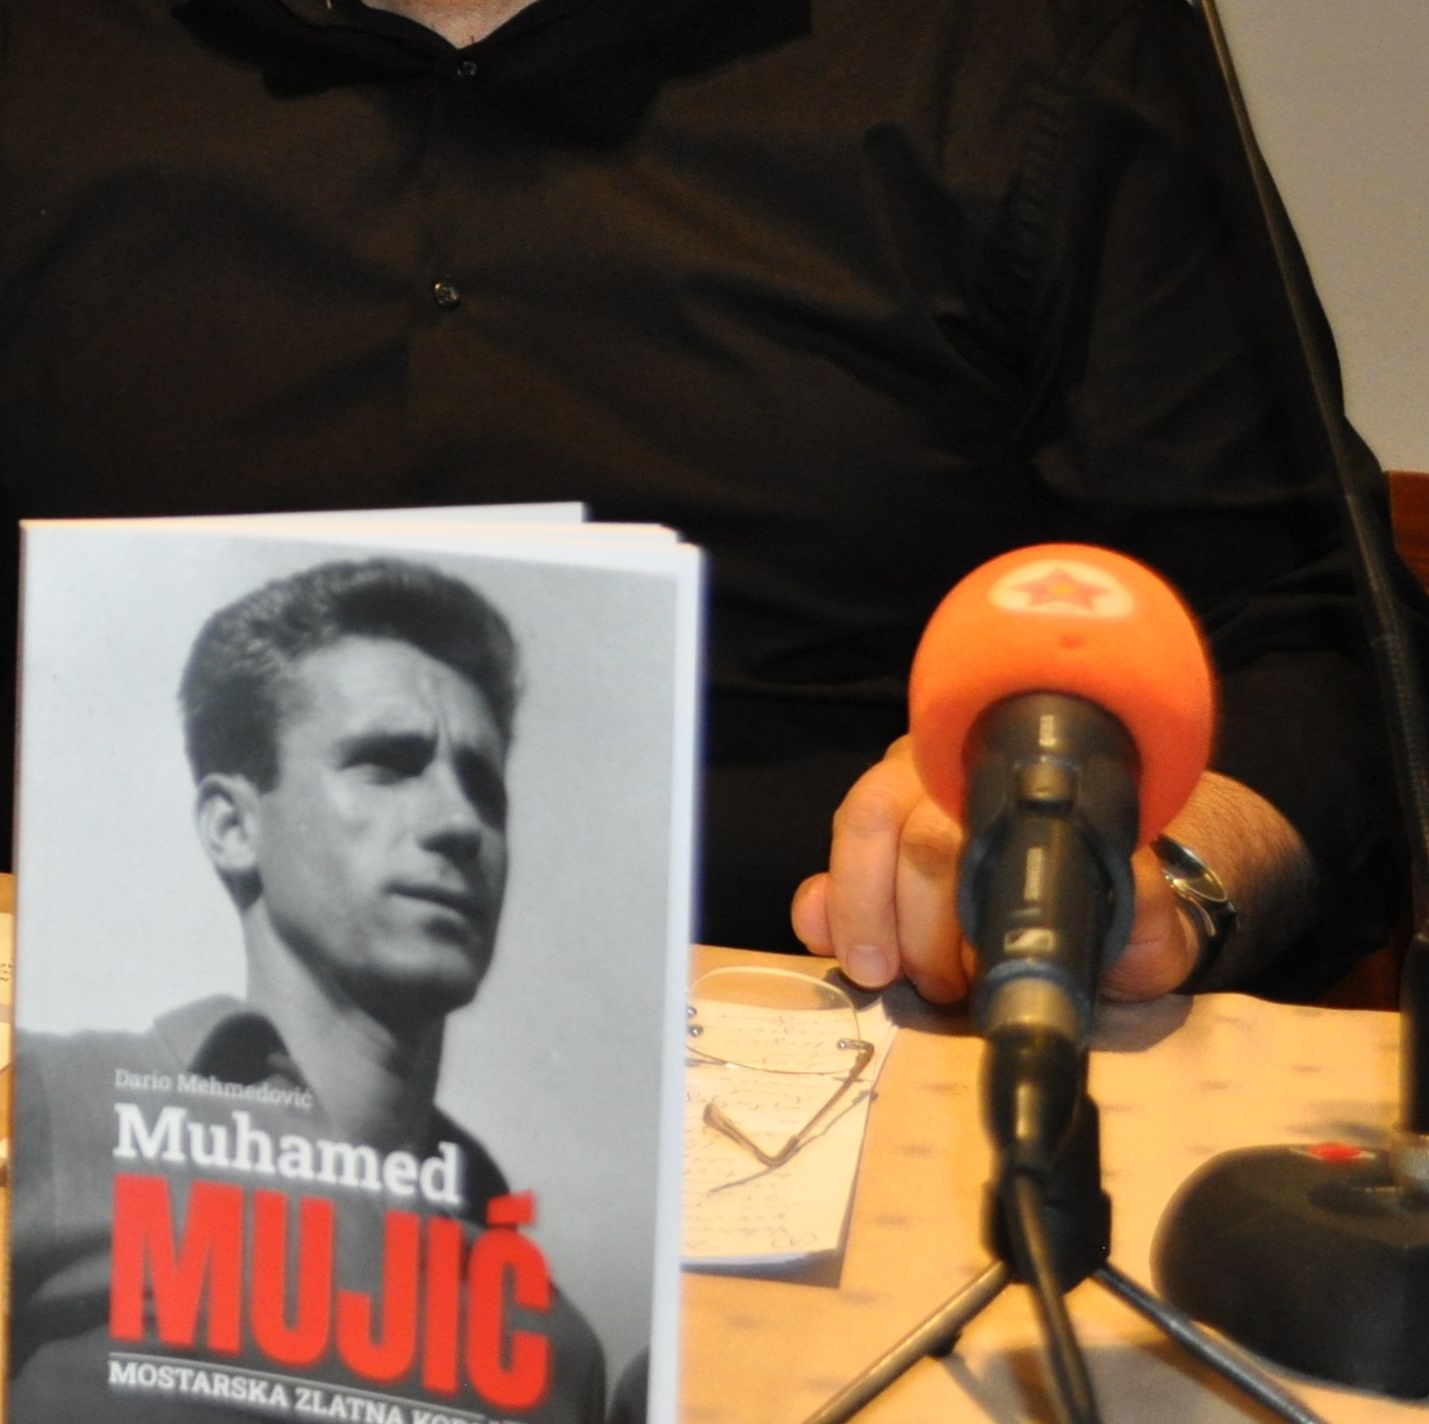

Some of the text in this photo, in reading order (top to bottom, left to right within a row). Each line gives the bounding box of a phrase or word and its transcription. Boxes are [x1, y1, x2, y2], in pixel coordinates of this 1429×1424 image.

[114, 1067, 314, 1109] Dario Mehmedović
[111, 1101, 463, 1207] Muhamed
[108, 1171, 554, 1411] MUJIĆ
[108, 1360, 403, 1424] MOSTARSKA ZLATNA
